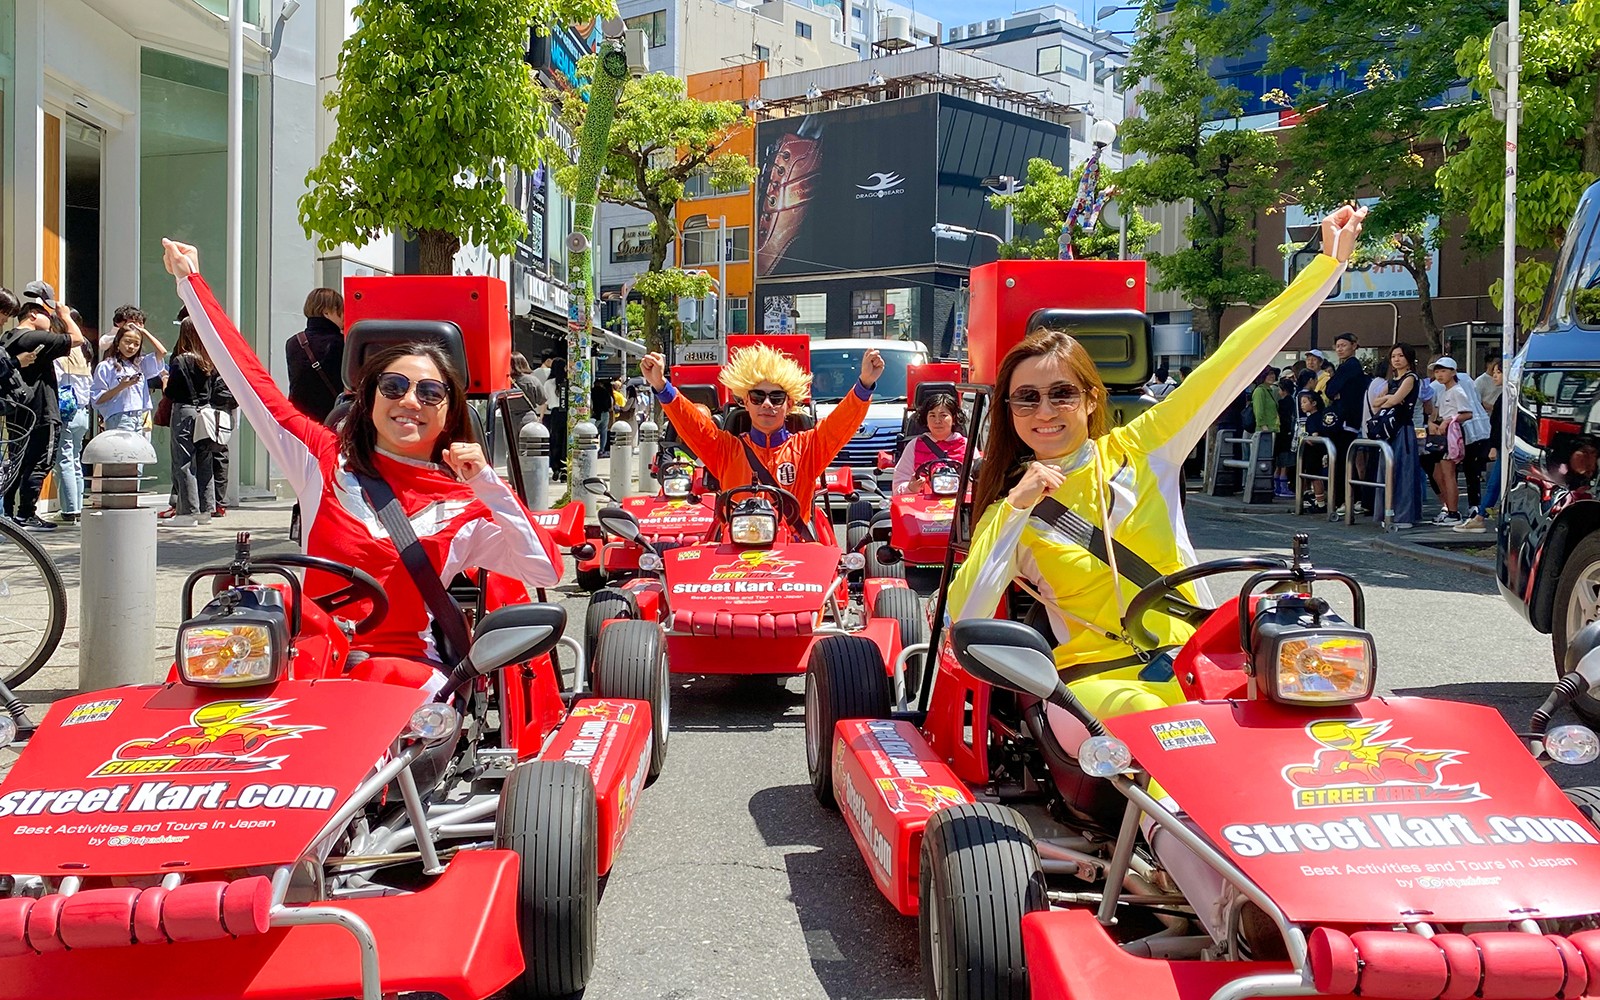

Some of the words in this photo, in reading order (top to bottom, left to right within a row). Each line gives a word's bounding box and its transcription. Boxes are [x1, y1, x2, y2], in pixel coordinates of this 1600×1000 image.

[779, 462, 795, 486] 亀
[638, 517, 662, 525] reet
[672, 581, 731, 594] street
[734, 581, 775, 593] Kart
[777, 582, 823, 593] .com
[125, 781, 230, 812] Kart
[223, 784, 338, 811] .com
[14, 825, 53, 835] Best
[54, 823, 129, 834] Activities
[132, 822, 162, 832] and
[166, 821, 208, 831] Tours
[229, 819, 276, 830] Japan
[1370, 813, 1486, 848] Kart
[1488, 816, 1600, 846] .com
[88, 837, 106, 847] by
[1300, 864, 1342, 877] Best
[1345, 862, 1422, 875] Activities
[1426, 860, 1456, 872] and
[1456, 860, 1506, 871] Tours
[1528, 856, 1578, 868] Japan
[1396, 878, 1413, 889] by
